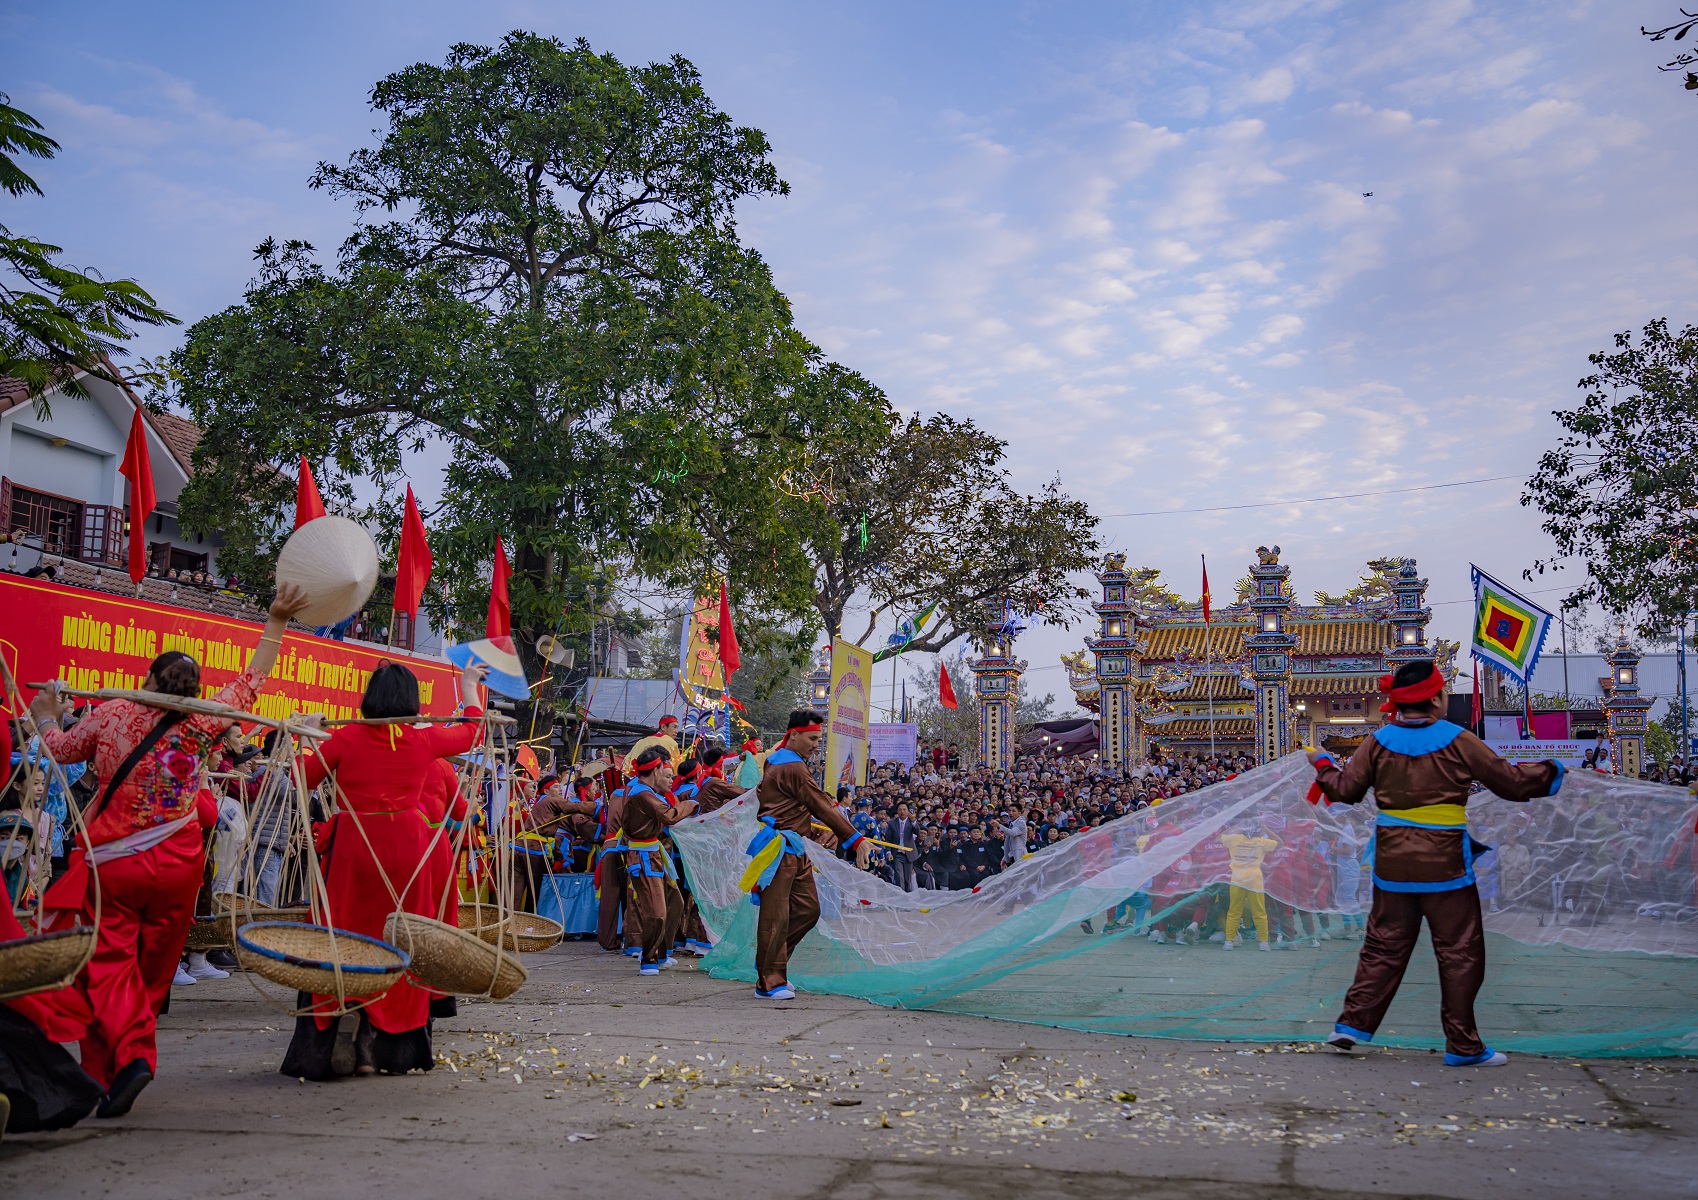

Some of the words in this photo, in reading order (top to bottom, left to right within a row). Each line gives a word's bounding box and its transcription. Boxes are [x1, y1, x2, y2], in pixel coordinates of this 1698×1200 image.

[62, 611, 112, 653] MỪNG
[205, 638, 243, 675] XUÂN,
[282, 646, 297, 681] LỄ
[297, 654, 318, 690] HỘI
[319, 660, 359, 693] TRUYỀN
[418, 679, 435, 706] GƯ
